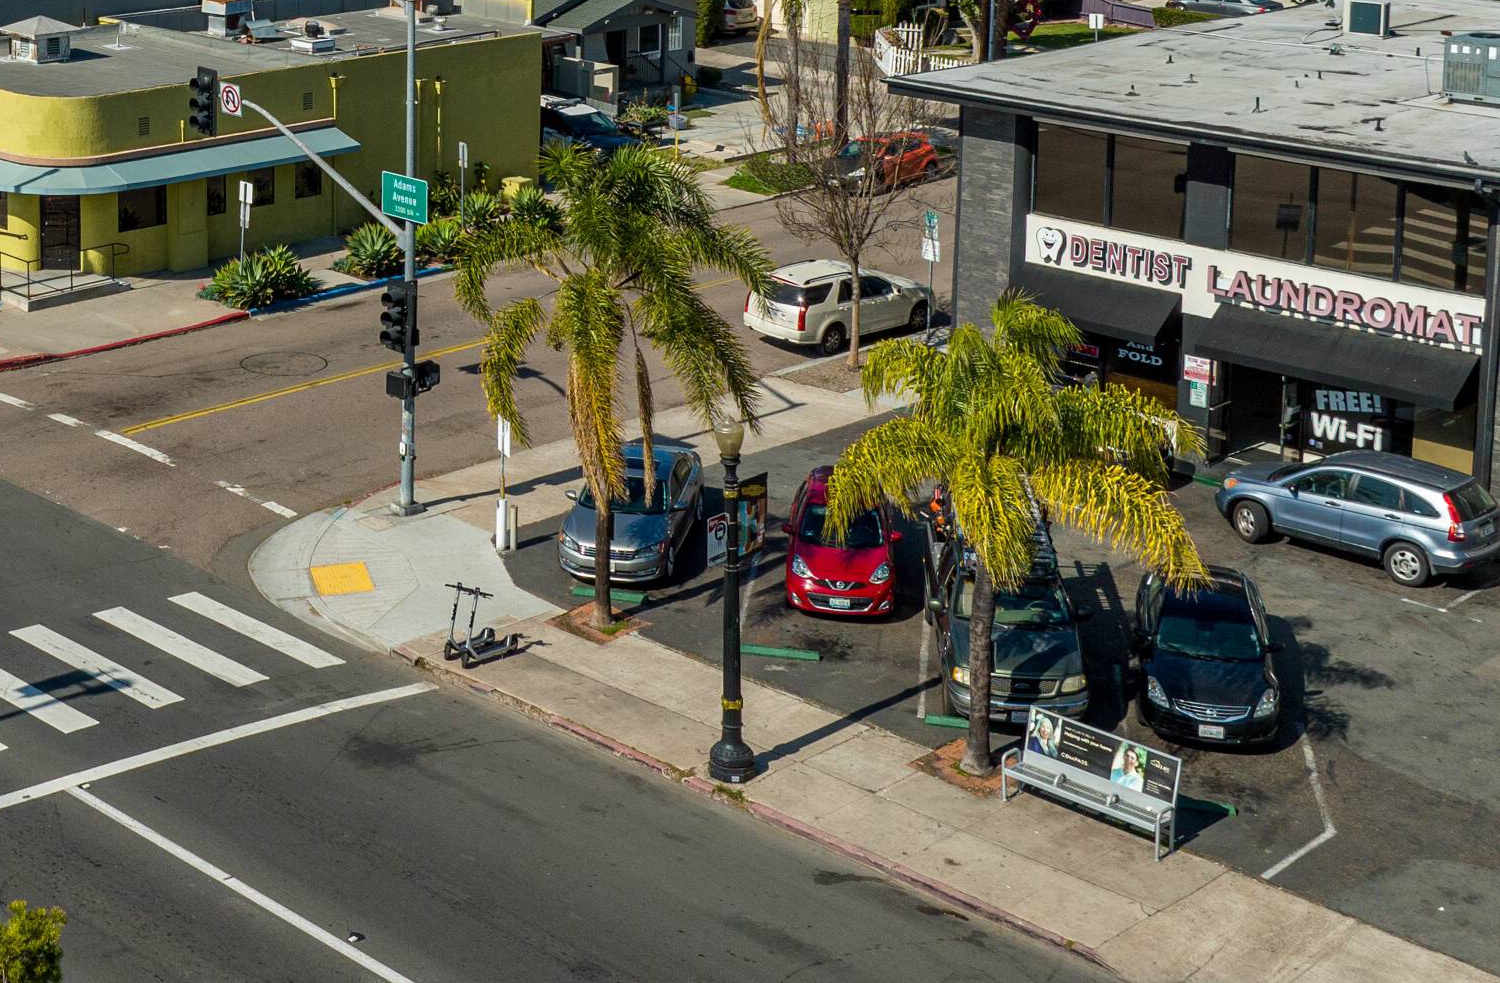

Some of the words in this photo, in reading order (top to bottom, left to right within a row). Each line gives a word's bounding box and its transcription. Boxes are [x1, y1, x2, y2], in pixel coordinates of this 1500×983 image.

[392, 191, 417, 206] Avenue
[393, 179, 416, 193] Adams
[1070, 234, 1190, 287] DENTIST
[1207, 265, 1481, 346] LAUNDROMAT
[1117, 348, 1163, 366] FOLD
[1315, 389, 1382, 414] FREE!
[1310, 412, 1383, 451] Wi-Fi
